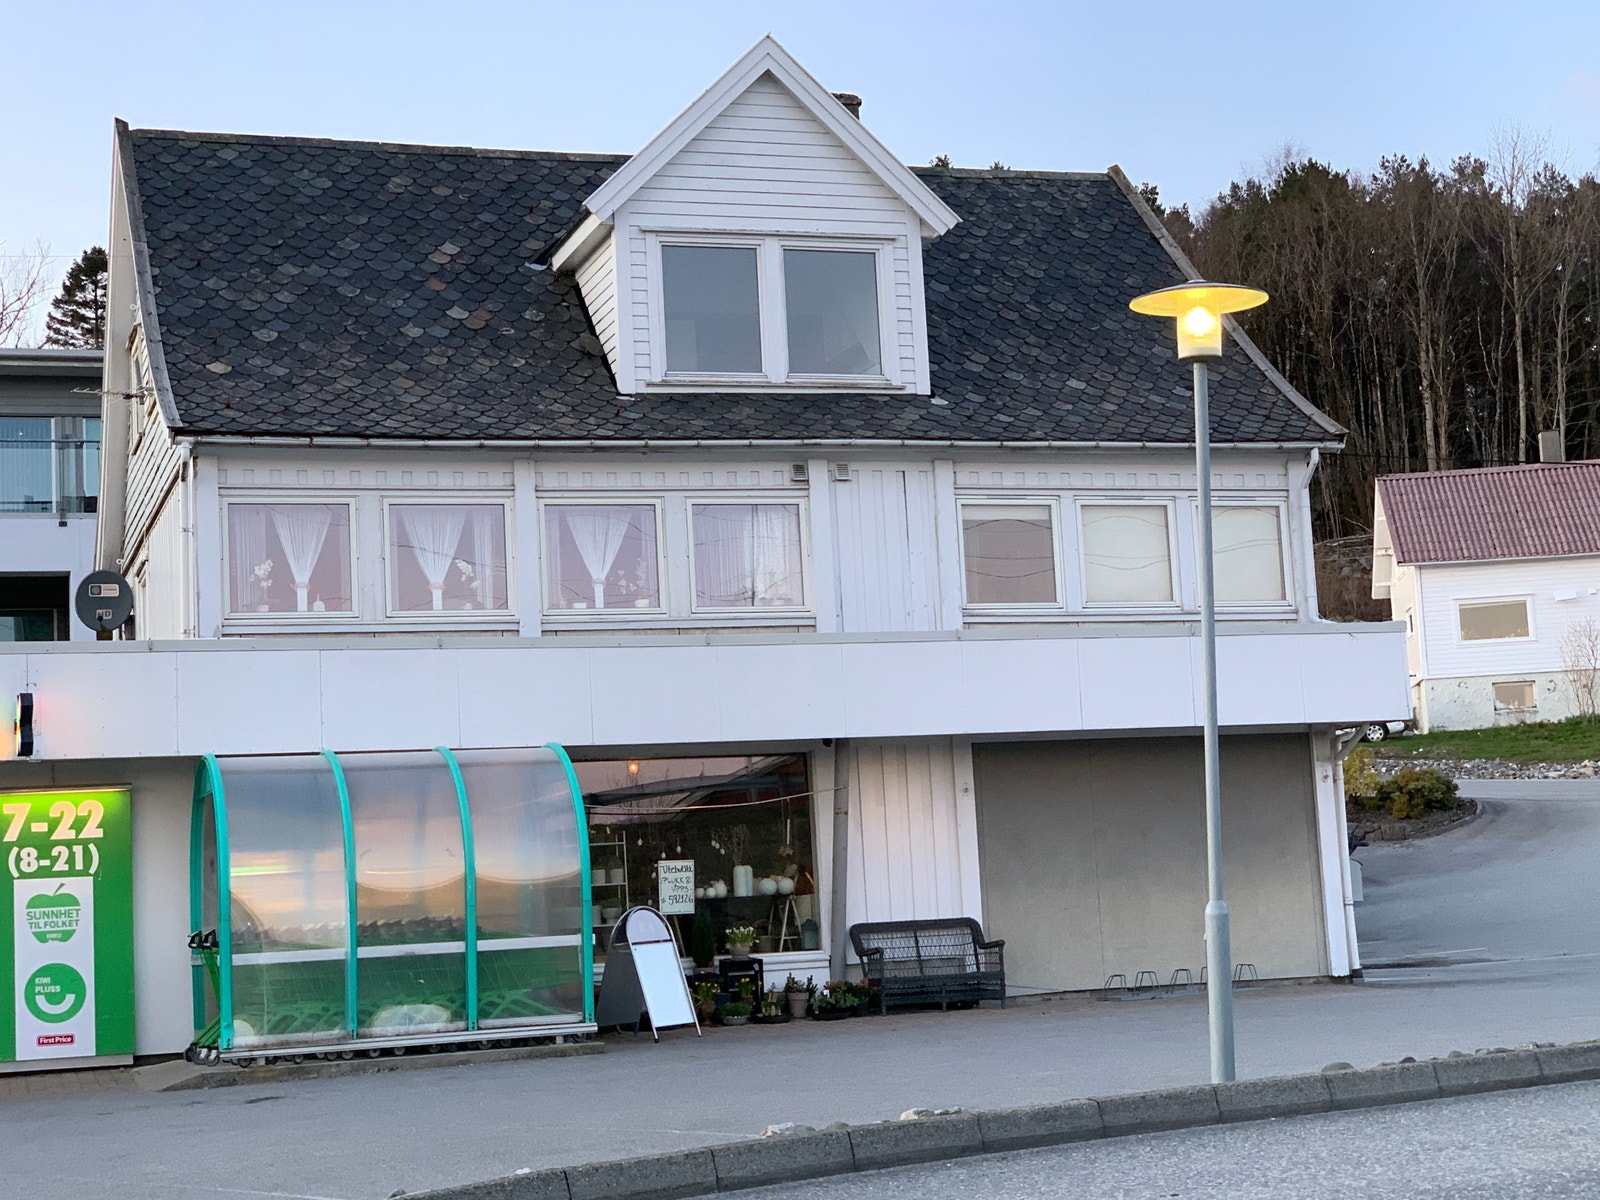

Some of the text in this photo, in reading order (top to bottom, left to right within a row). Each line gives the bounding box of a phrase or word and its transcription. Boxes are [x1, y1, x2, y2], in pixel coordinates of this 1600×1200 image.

[2, 799, 104, 842] 7-22
[8, 843, 99, 878] (8-21)
[26, 908, 81, 921] SUNNHET
[28, 919, 80, 930] TIL FOLKET
[35, 977, 51, 985] KIWI
[35, 985, 61, 993] PLUSS
